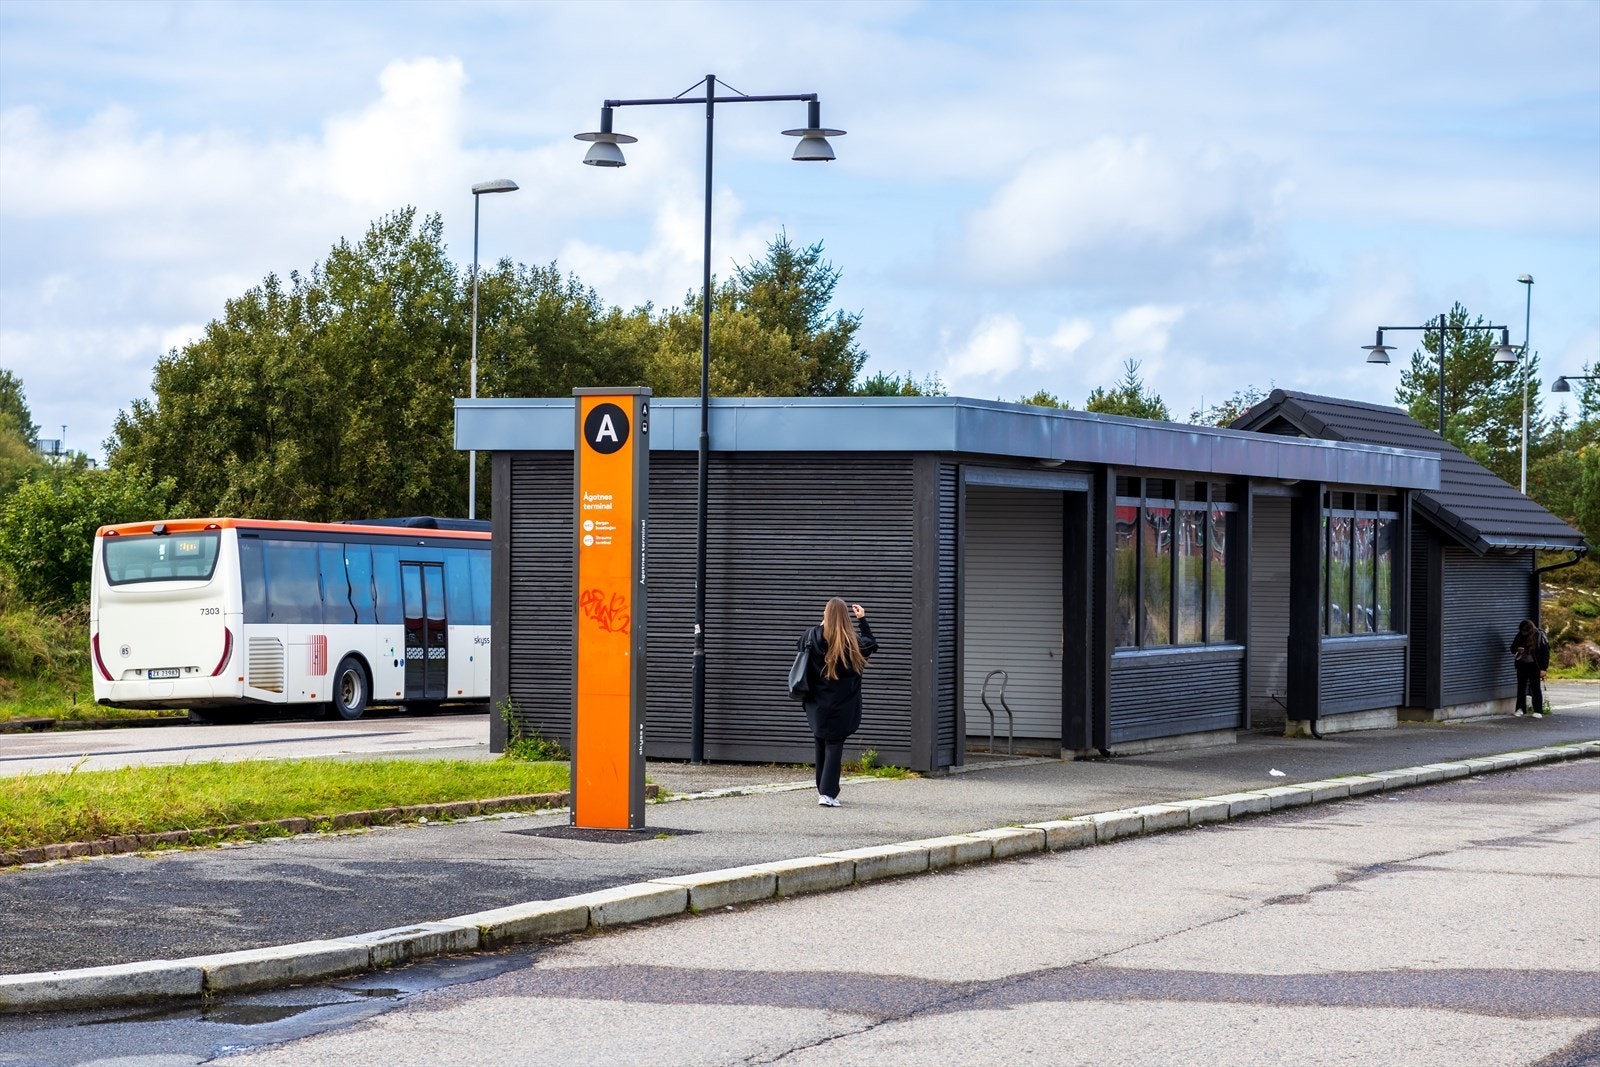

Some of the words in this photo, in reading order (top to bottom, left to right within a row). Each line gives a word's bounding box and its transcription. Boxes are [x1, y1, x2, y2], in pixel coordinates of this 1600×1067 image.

[643, 405, 648, 414] A
[596, 414, 618, 442] A
[584, 492, 612, 502] Ågotnes
[200, 607, 220, 616] 7303
[474, 636, 490, 646] skyss
